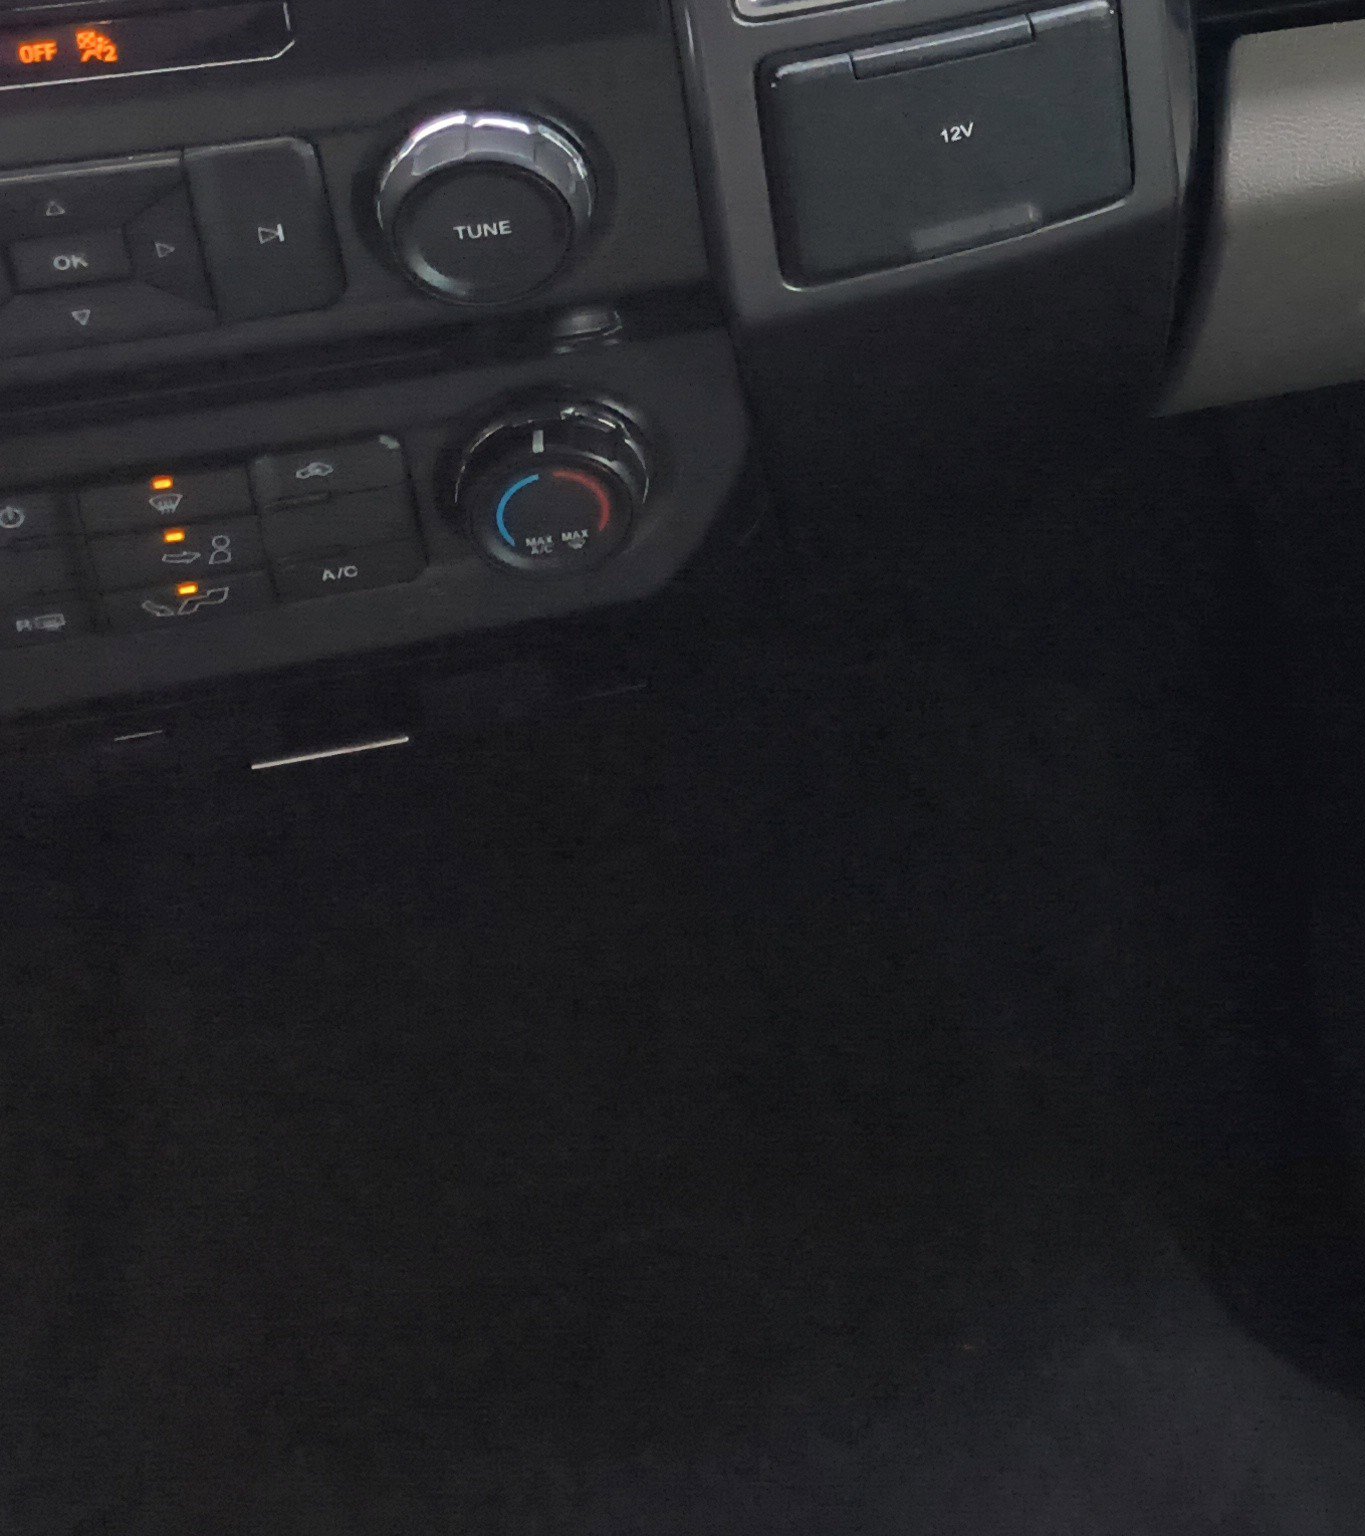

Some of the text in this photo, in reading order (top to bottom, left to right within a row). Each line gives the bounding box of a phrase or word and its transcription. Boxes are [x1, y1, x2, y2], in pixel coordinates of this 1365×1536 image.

[19, 40, 58, 65] OFF
[940, 122, 974, 143] 12V
[453, 219, 512, 241] TUNE
[53, 252, 89, 271] OK
[561, 528, 589, 542] MAX
[321, 564, 359, 582] A/C
